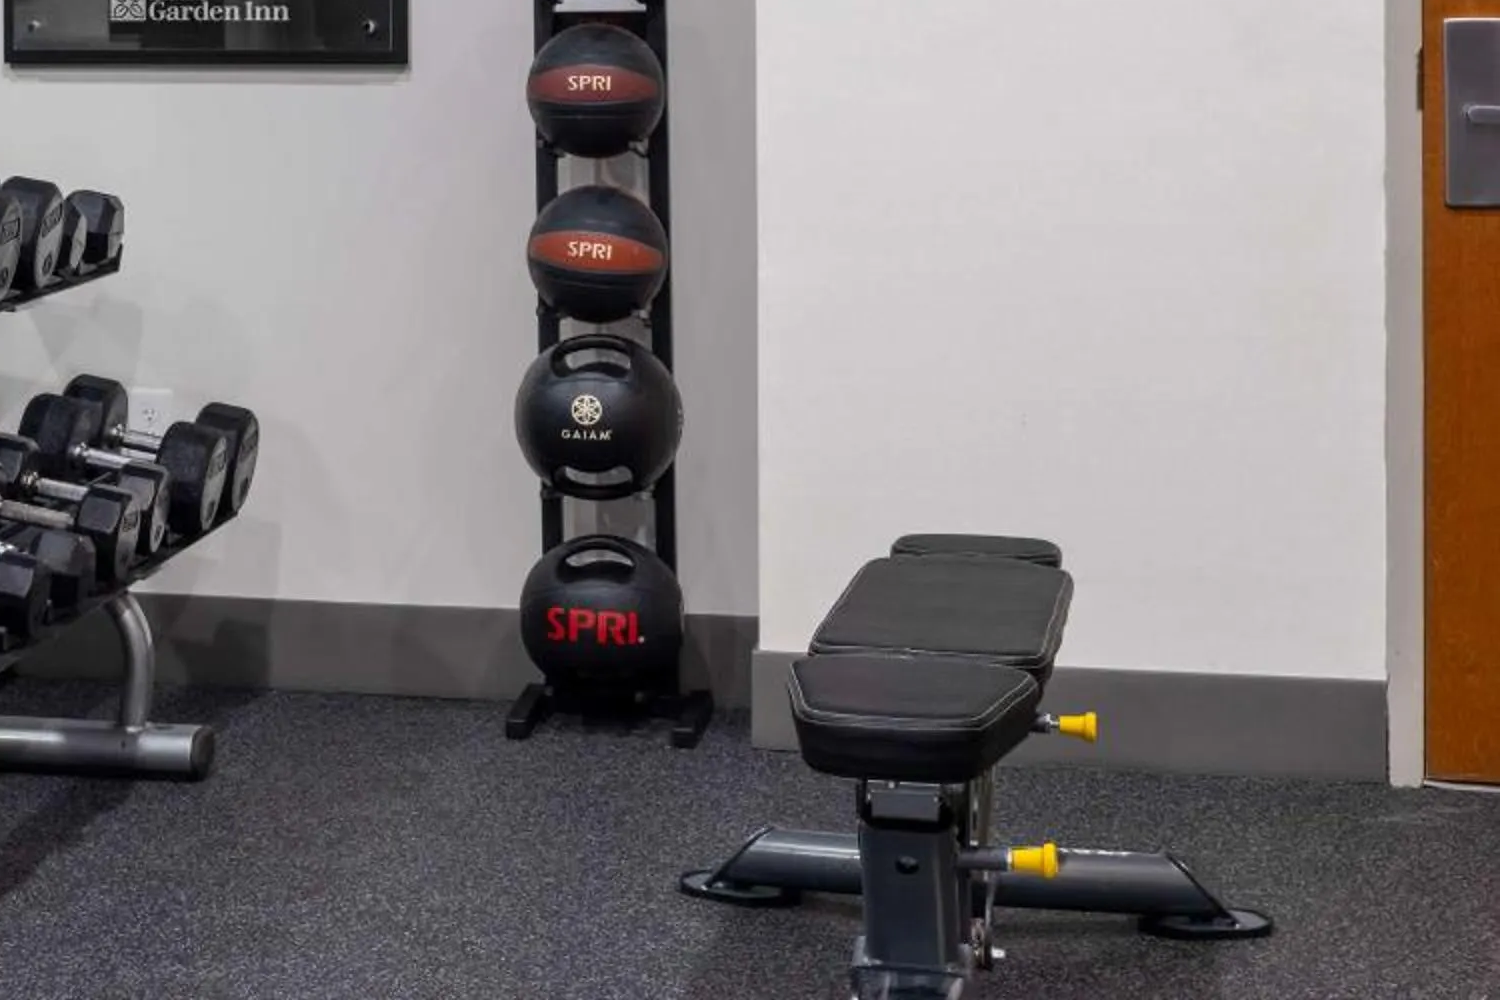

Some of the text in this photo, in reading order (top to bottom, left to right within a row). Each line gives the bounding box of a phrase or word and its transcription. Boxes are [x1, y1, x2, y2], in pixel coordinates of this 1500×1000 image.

[149, 1, 289, 21] Garden Inn
[567, 75, 611, 92] SPRI
[567, 241, 613, 261] SPRI
[562, 429, 612, 440] GAIAM
[546, 607, 640, 645] SPRI
